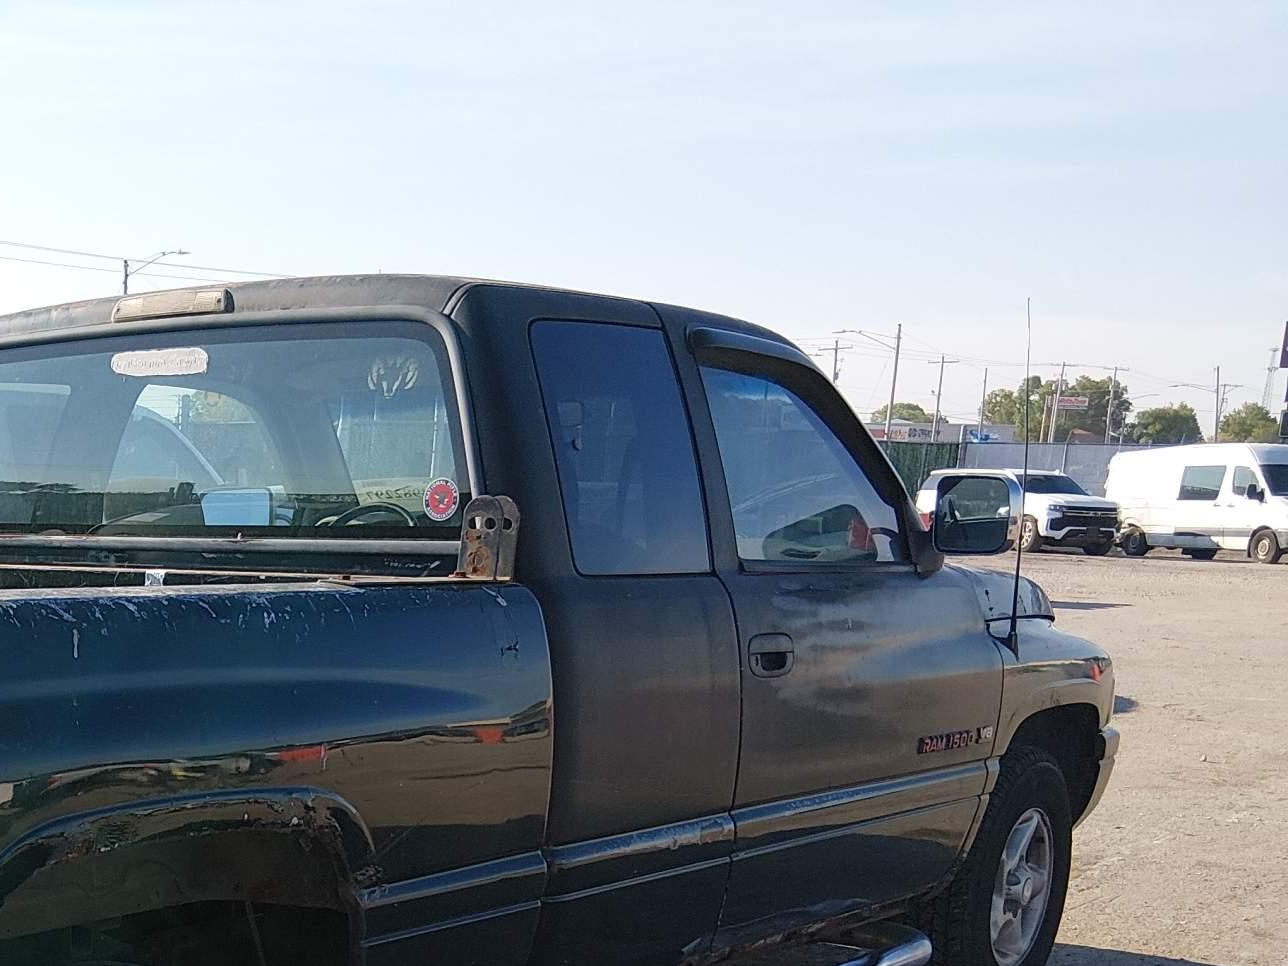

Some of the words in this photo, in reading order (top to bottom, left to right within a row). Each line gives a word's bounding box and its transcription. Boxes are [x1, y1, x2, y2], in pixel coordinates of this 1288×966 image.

[980, 727, 993, 739] V8
[922, 736, 946, 753] RAM
[948, 732, 974, 748] 1500
